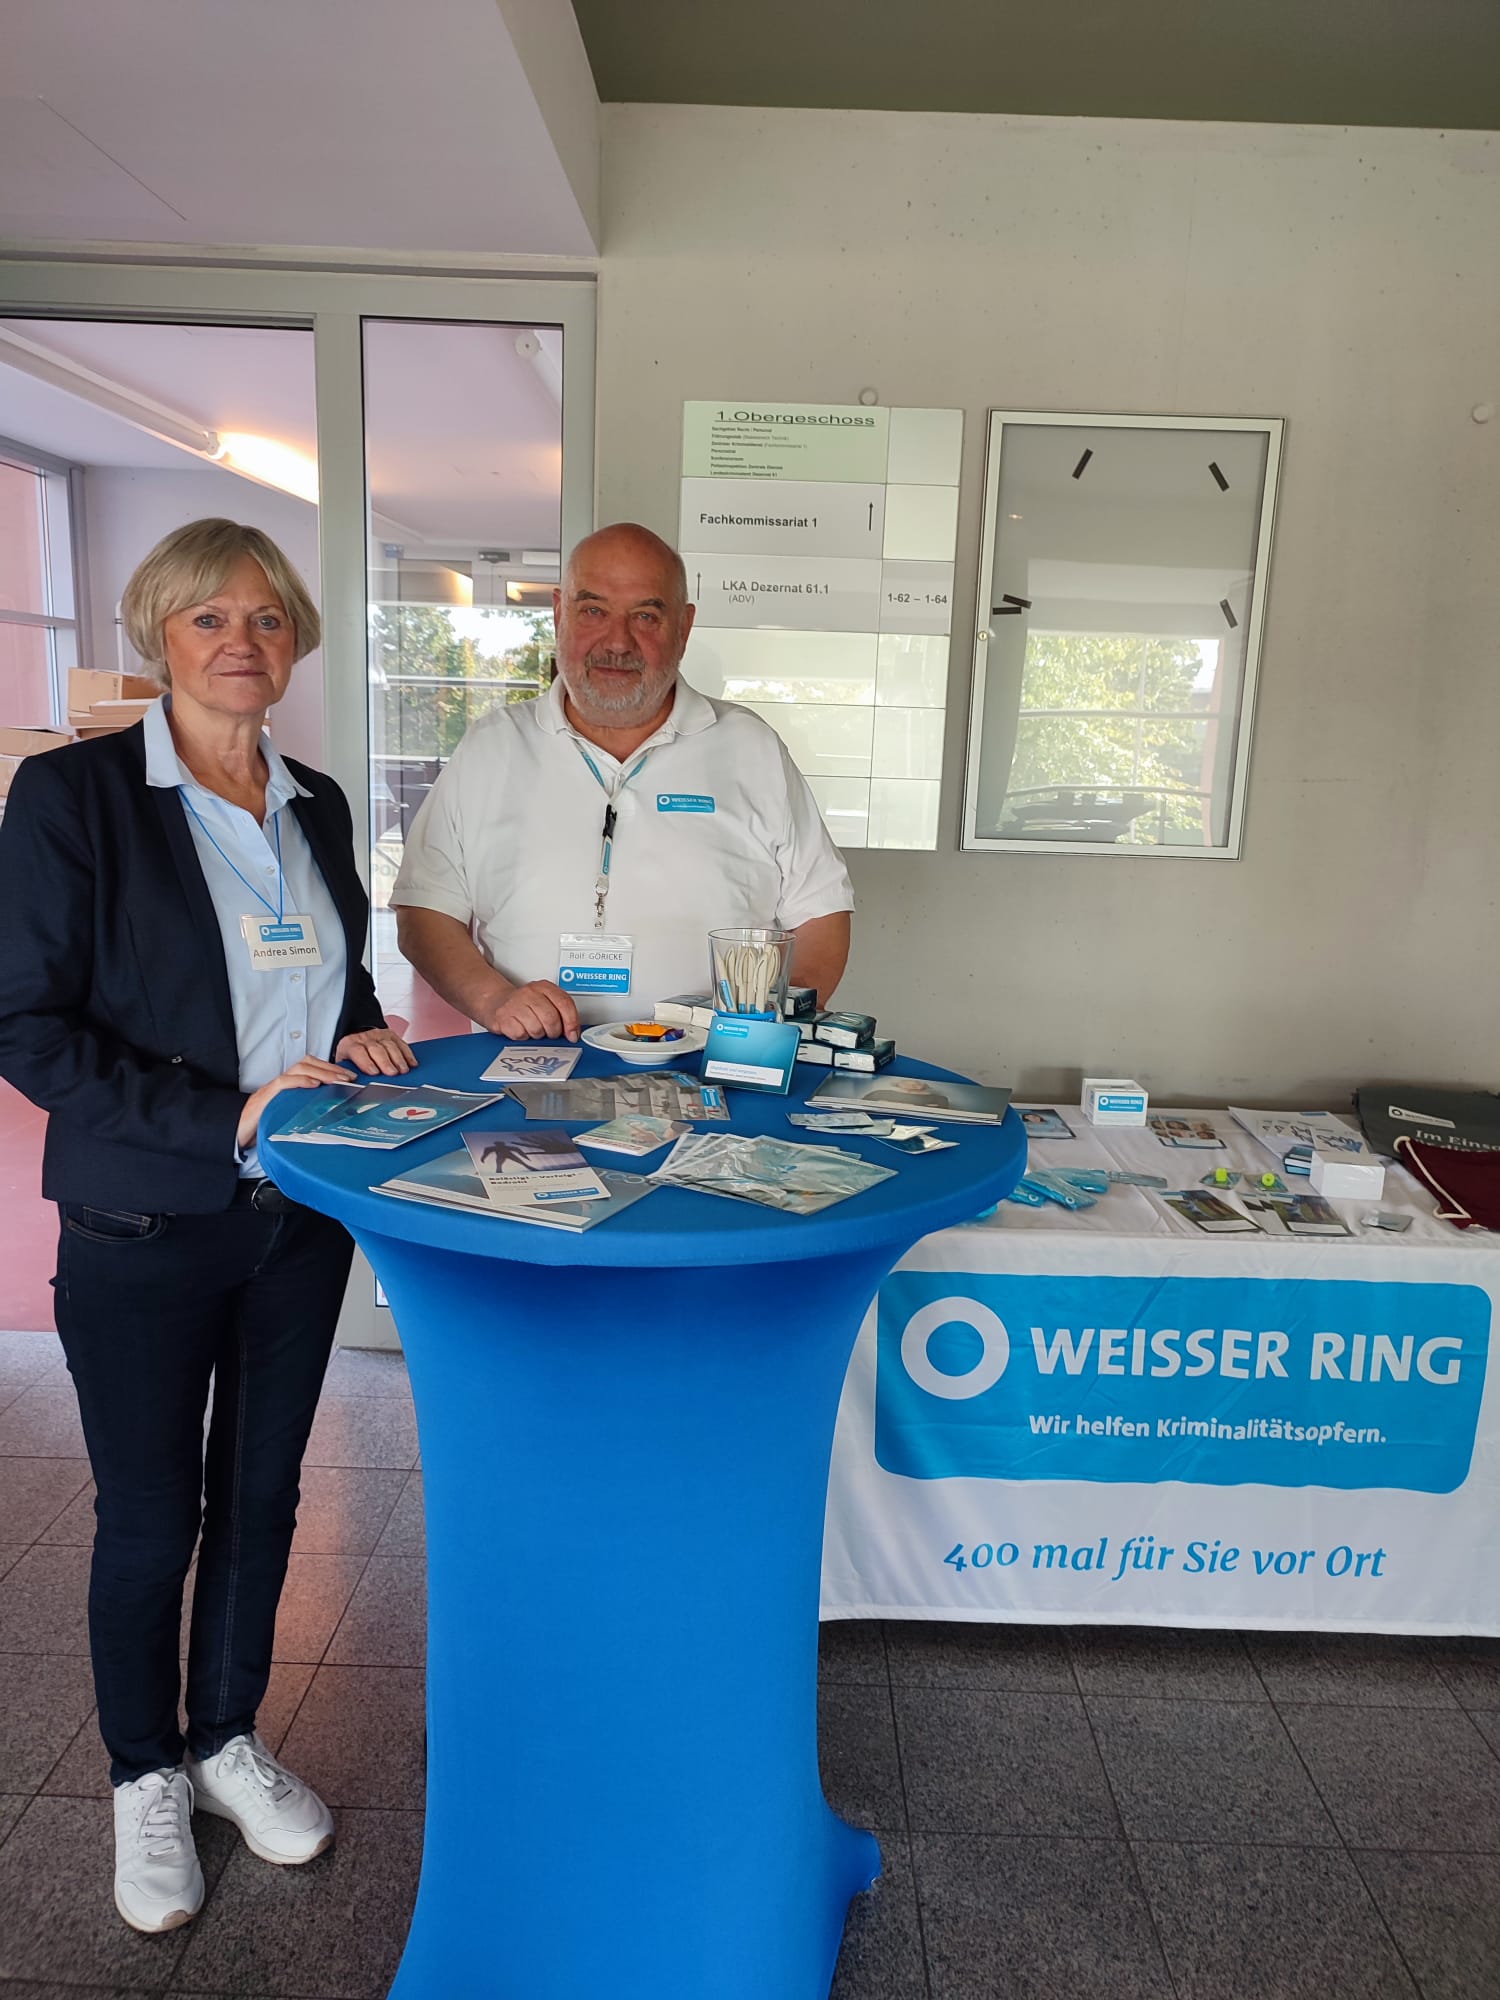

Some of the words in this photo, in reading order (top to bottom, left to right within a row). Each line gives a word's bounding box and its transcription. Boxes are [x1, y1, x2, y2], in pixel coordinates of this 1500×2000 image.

[716, 410, 875, 426] 1.Obergeschoss
[700, 513, 808, 528] Fachkommissariat
[812, 517, 817, 528] 1
[722, 580, 748, 592] LKA
[751, 581, 802, 594] Dezernat
[805, 583, 829, 595] 61.1
[728, 594, 755, 605] (ADV)
[887, 592, 911, 604] 1-62
[924, 593, 948, 605] 1-64
[253, 947, 288, 959] Andrea
[289, 945, 318, 956] Simon
[576, 972, 607, 980] WEISSER
[608, 973, 627, 981] RING
[1030, 1327, 1289, 1379] WEISSER
[1310, 1332, 1463, 1385] RING
[1029, 1415, 1069, 1434] Wir
[1076, 1414, 1150, 1437] helfen
[1156, 1417, 1387, 1445] Kriminalitätsopfern.
[943, 1542, 1019, 1571] 400
[1032, 1537, 1108, 1570] mal
[1111, 1535, 1174, 1580] für
[1182, 1540, 1240, 1573] Sie
[1252, 1548, 1315, 1575] vor
[1326, 1546, 1386, 1577] Ort
